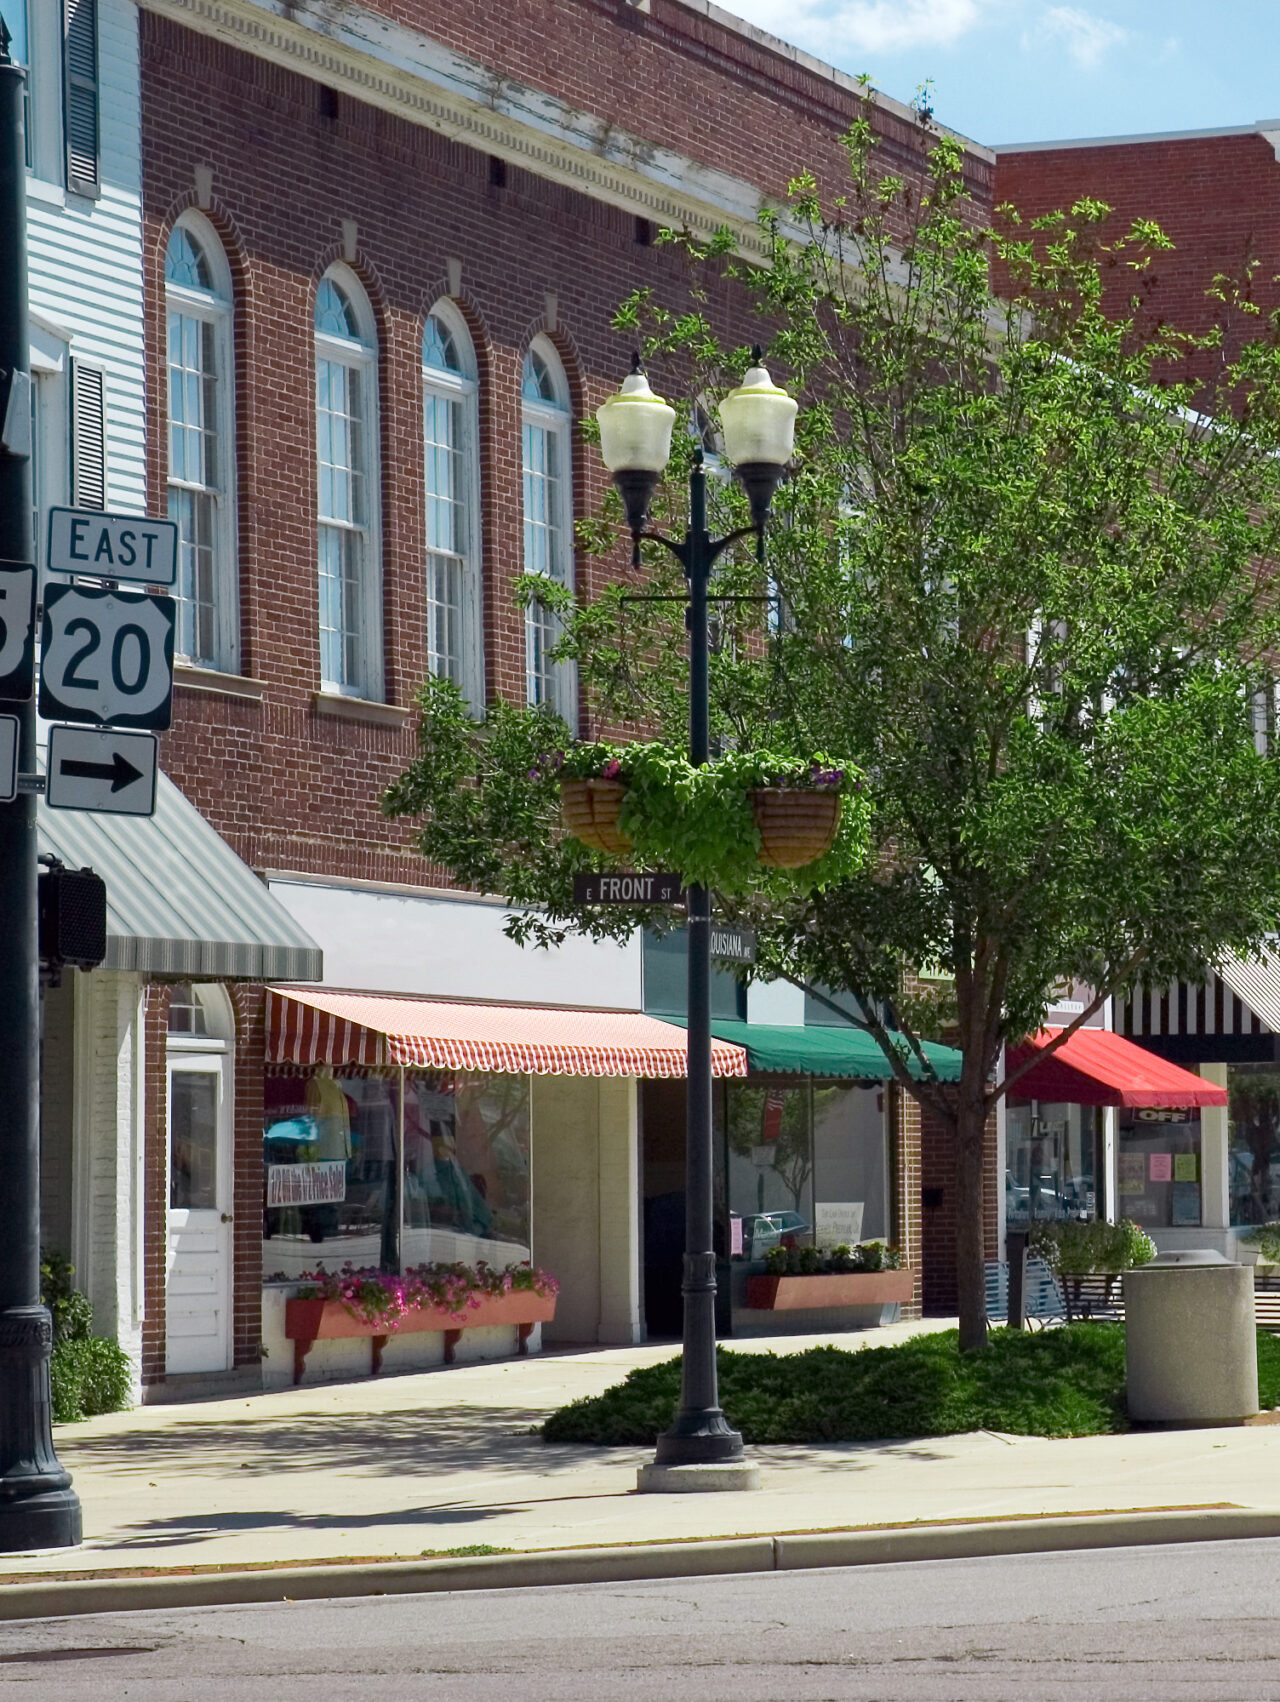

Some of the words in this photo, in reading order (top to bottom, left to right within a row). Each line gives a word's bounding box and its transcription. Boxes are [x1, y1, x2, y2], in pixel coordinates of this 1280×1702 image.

[69, 518, 159, 569] EAST
[61, 617, 151, 696] 20
[586, 888, 592, 900] E
[600, 877, 655, 900] FRONT
[661, 888, 672, 900] ST
[711, 931, 742, 957] OUISIANA
[1139, 1110, 1186, 1122] OFF
